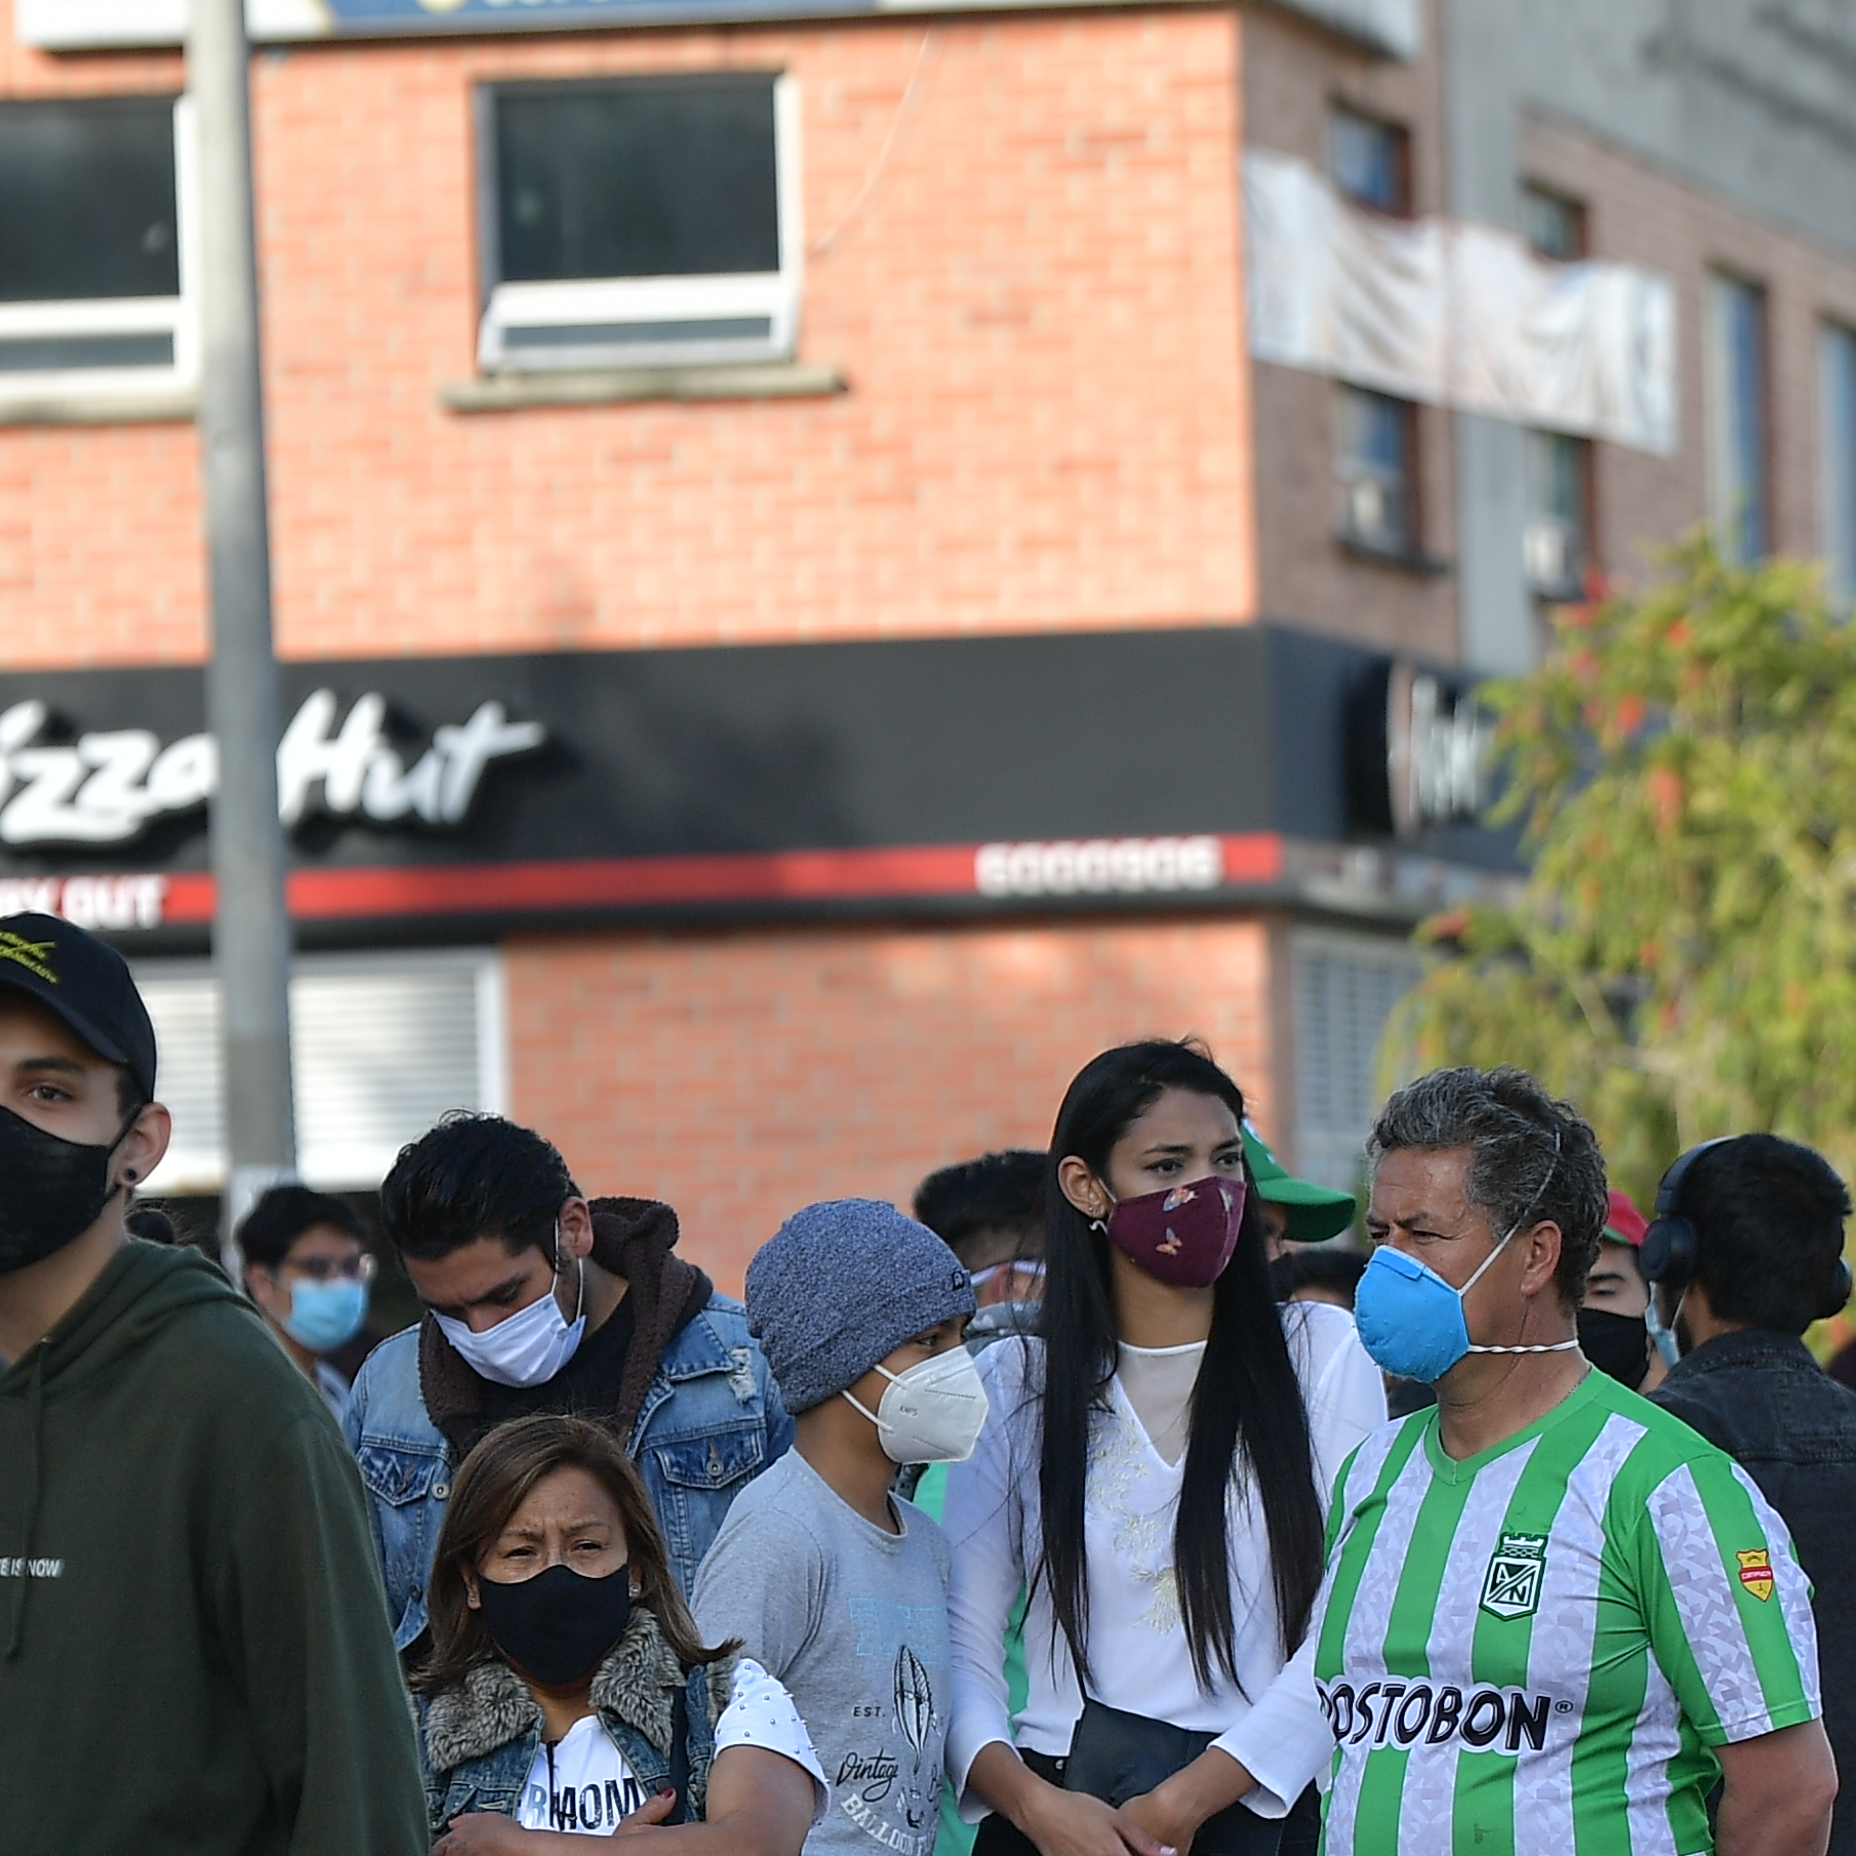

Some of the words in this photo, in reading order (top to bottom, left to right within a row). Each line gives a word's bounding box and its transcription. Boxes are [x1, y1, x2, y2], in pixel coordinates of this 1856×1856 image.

[275, 687, 541, 825] Hut
[62, 875, 167, 929] OUT
[11, 1557, 25, 1577] IS
[27, 1557, 64, 1578] NOW
[853, 1706, 885, 1718] EST.
[836, 1748, 900, 1803] Vintage
